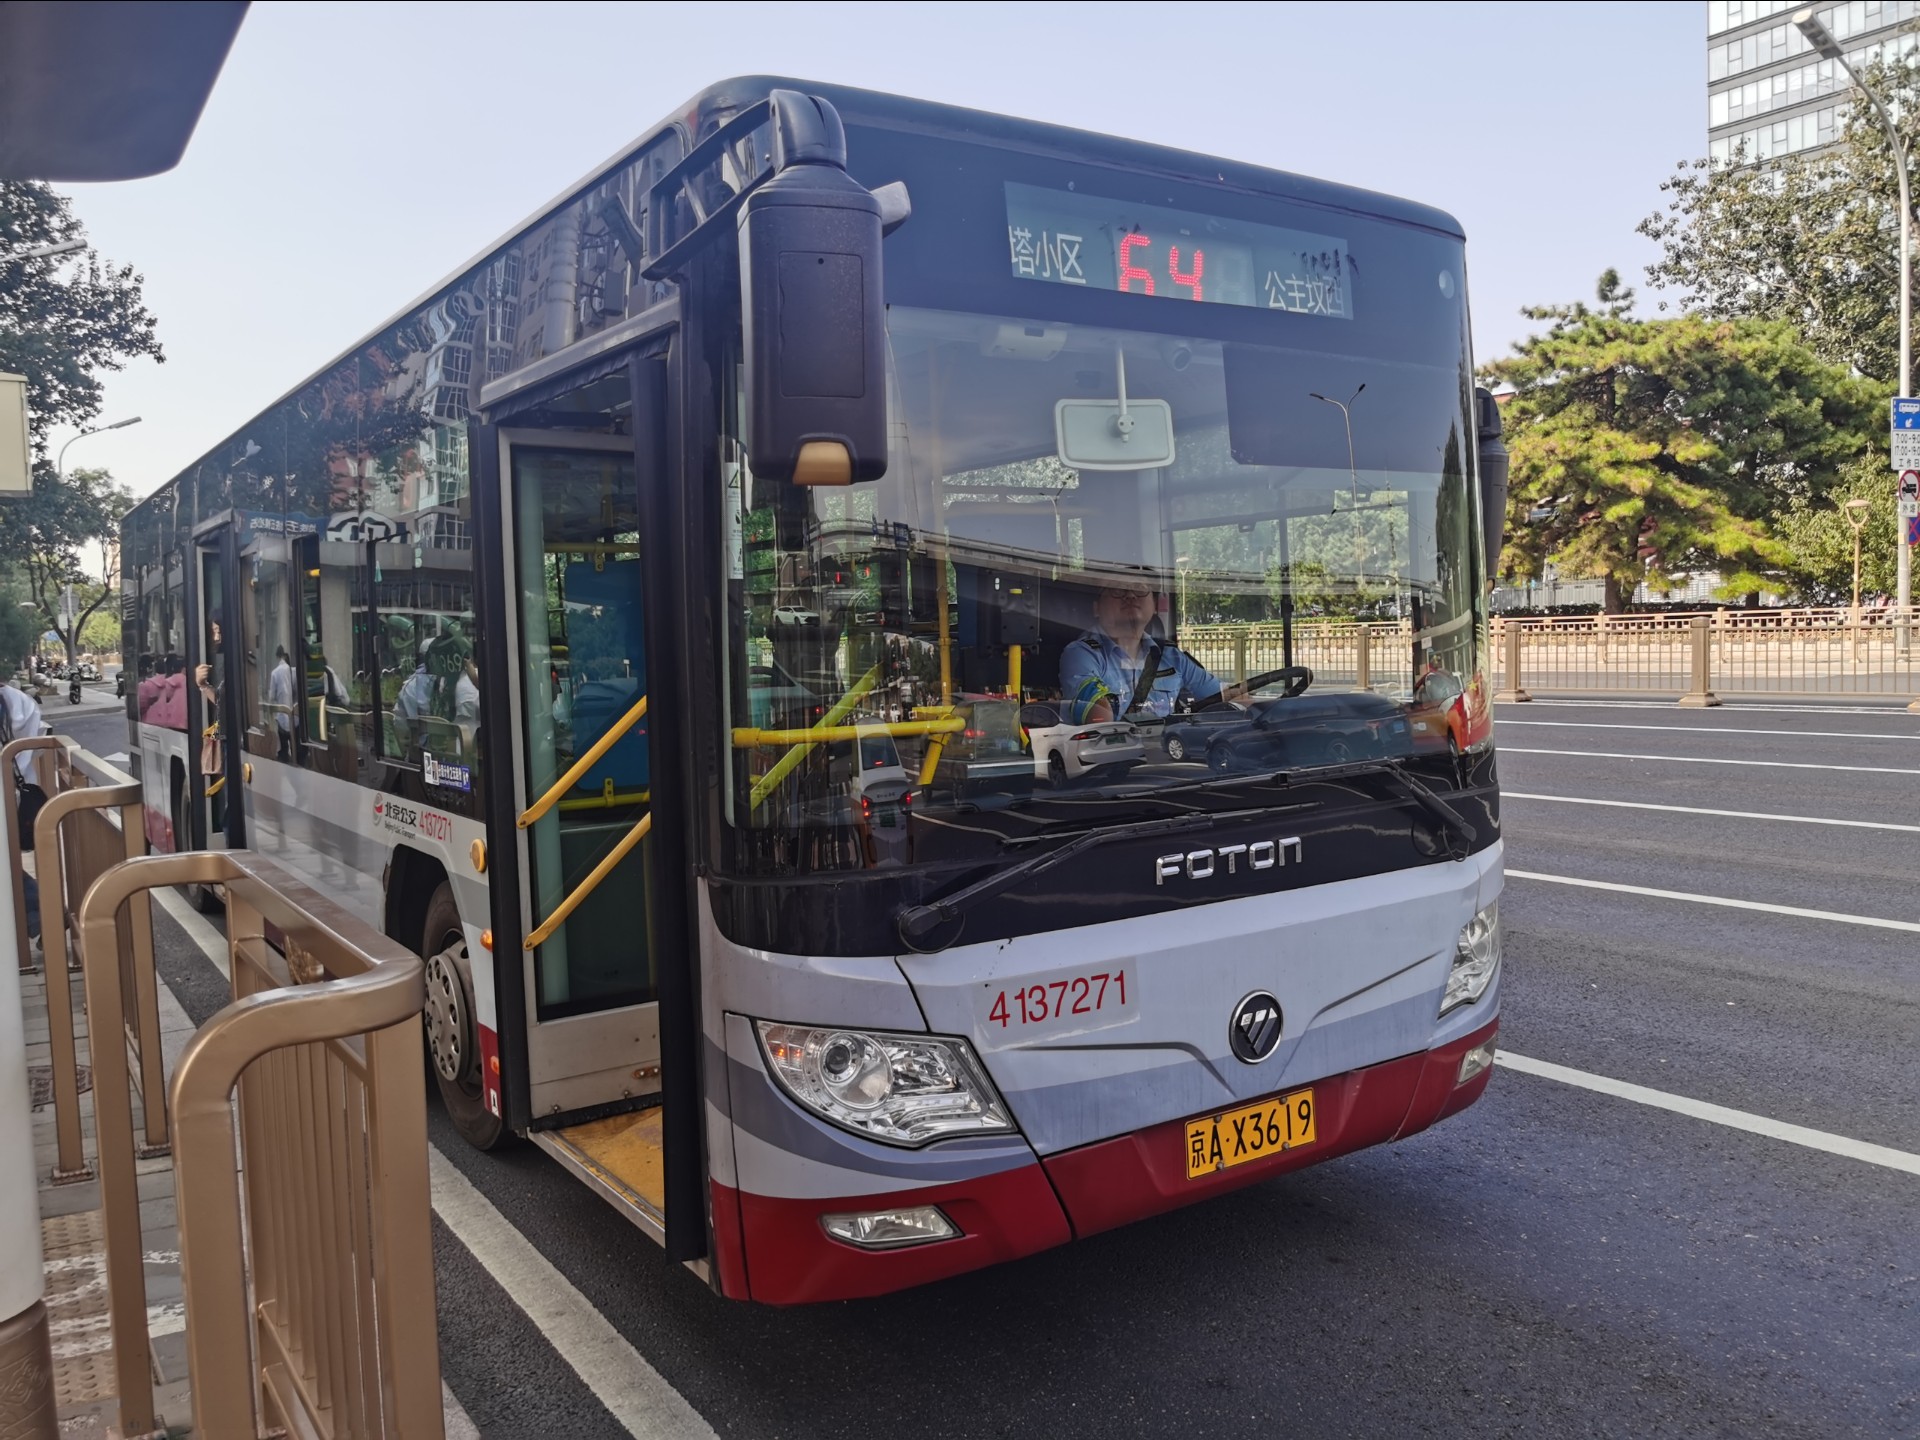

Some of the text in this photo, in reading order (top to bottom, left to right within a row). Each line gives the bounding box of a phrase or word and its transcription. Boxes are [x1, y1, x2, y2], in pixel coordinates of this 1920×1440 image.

[1008, 225, 1087, 284] 塔小区
[1118, 233, 1205, 302] 64
[1264, 271, 1345, 317] 公主坟西
[384, 801, 417, 828] 北京公交
[419, 810, 453, 843] 4137271
[1155, 836, 1303, 886] FOTON
[988, 969, 1127, 1029] 4137271
